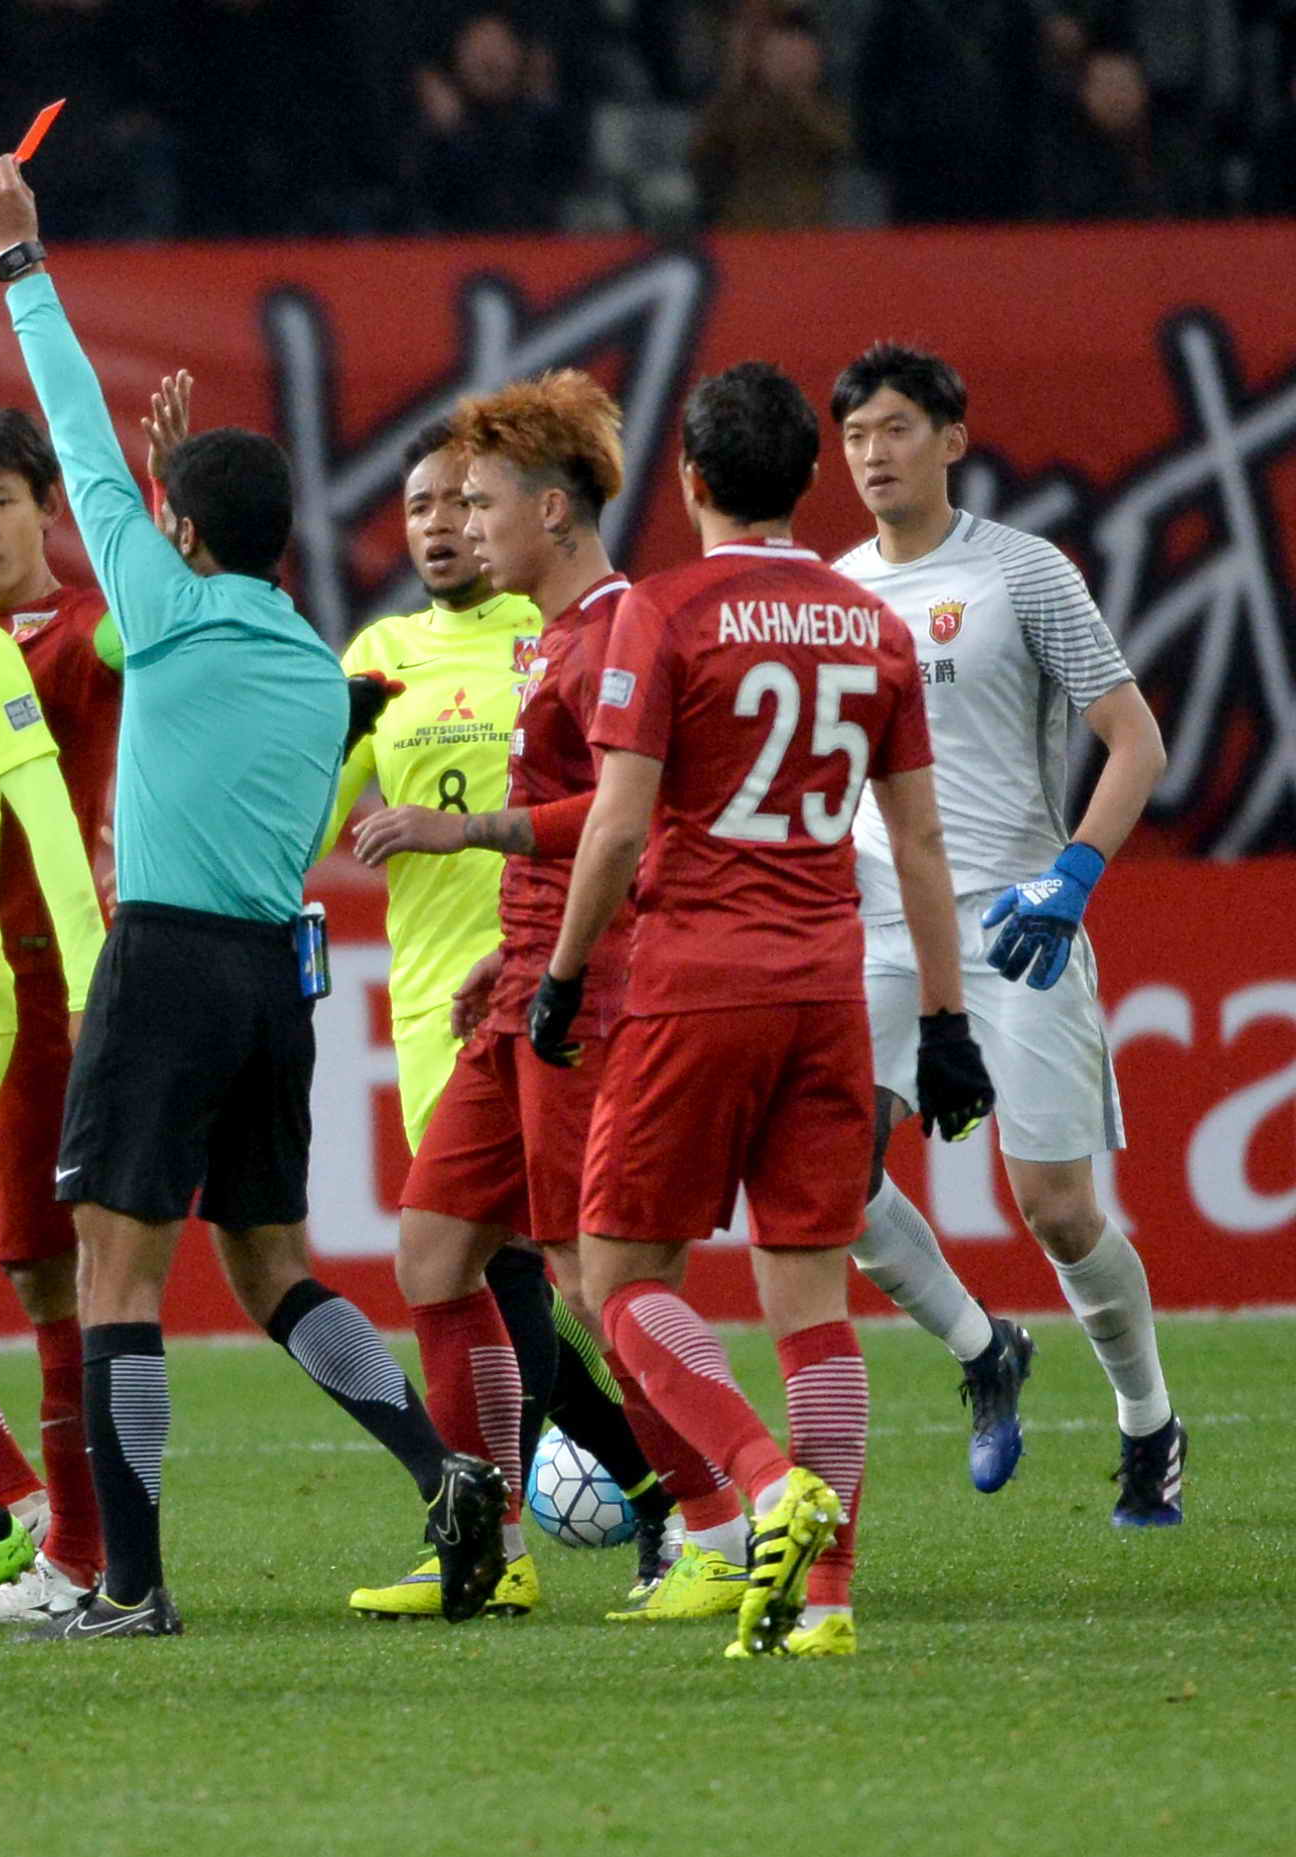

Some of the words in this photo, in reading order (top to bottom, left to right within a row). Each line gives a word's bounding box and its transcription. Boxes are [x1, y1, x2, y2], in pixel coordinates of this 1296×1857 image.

[718, 600, 880, 649] AKHMEDOV
[394, 738, 432, 750] HEAVY
[437, 732, 512, 744] INDUSTRIE
[415, 722, 494, 737] MITSUBISHI
[707, 660, 878, 846] 25
